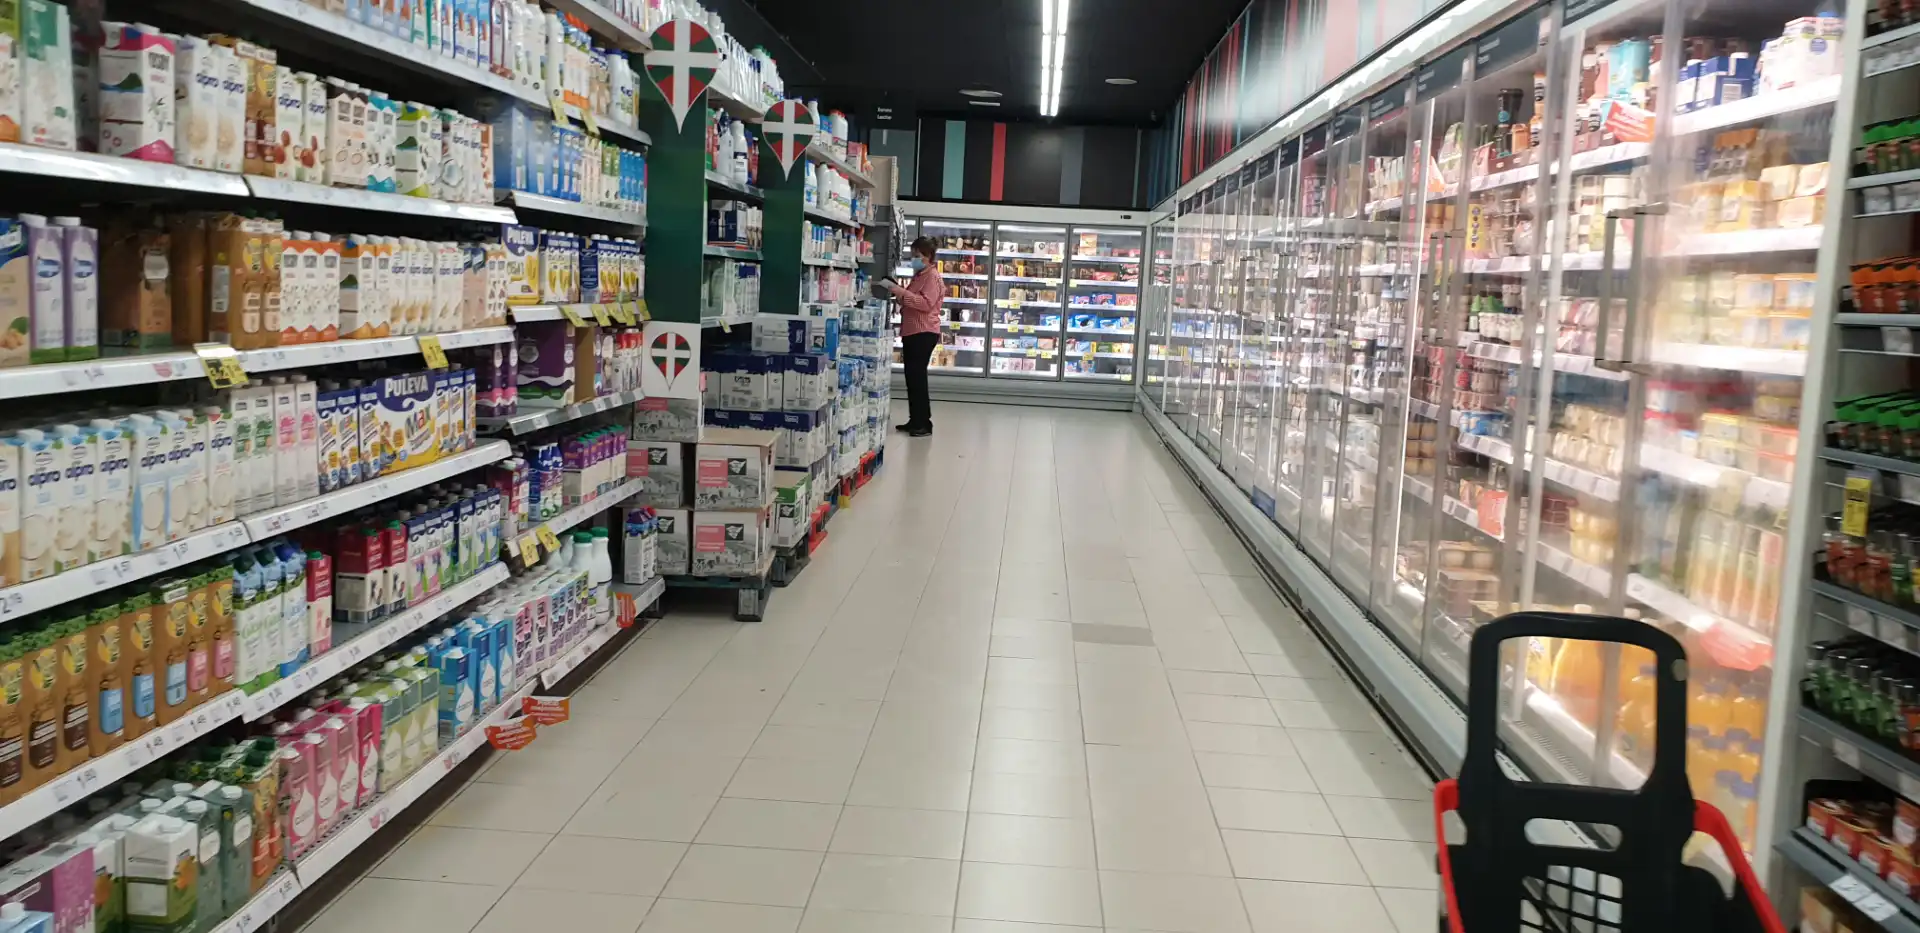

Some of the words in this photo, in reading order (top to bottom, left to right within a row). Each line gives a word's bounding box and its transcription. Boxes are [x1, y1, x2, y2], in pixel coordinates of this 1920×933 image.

[384, 375, 429, 399] PULEVA
[100, 458, 128, 476] alpro
[141, 454, 166, 471] alpro
[28, 471, 60, 489] alpro
[65, 464, 94, 482] alpro
